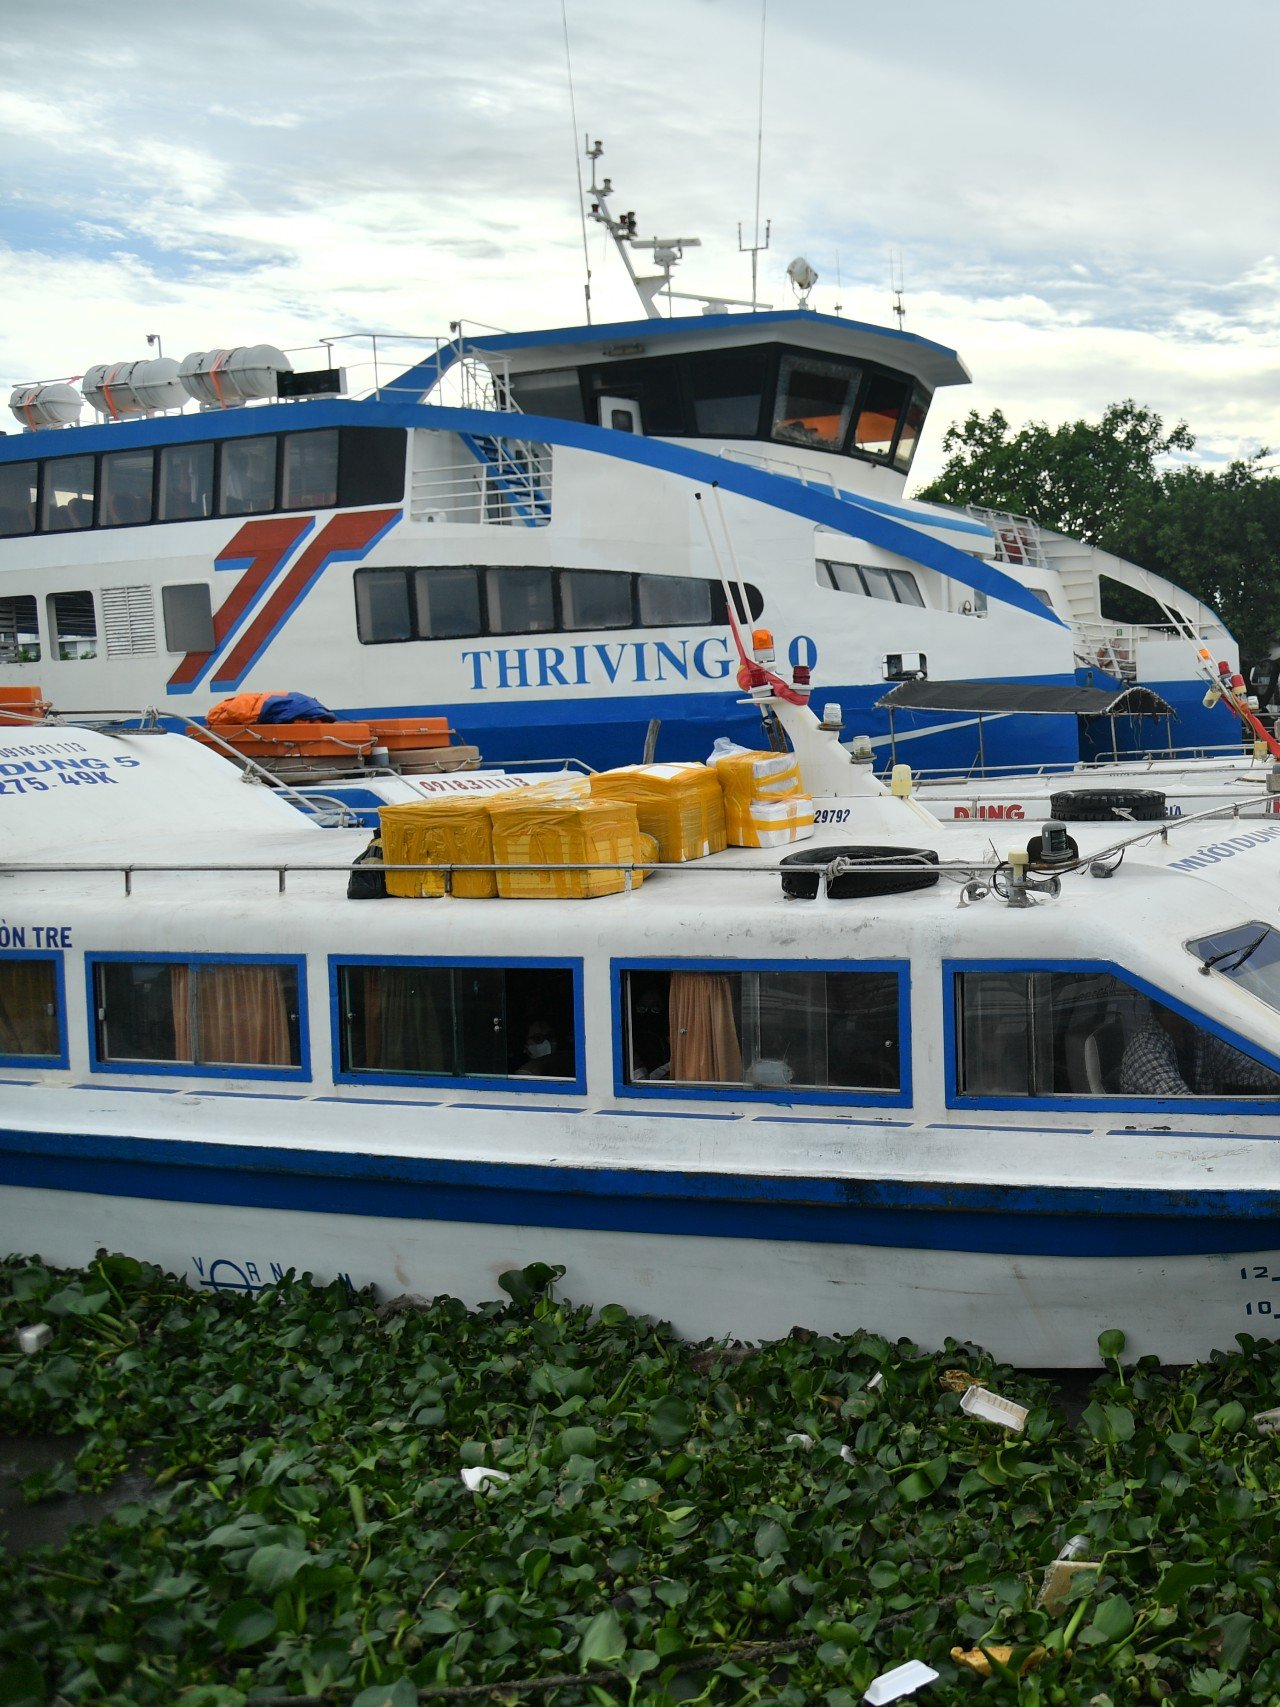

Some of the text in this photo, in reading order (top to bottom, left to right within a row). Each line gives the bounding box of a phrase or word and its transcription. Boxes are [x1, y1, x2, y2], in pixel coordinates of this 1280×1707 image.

[461, 637, 734, 690] THRIVING
[0, 756, 140, 776] DUNG 5
[32, 927, 72, 948] TRE
[1241, 1266, 1268, 1279] 12
[1246, 1301, 1271, 1315] 10
